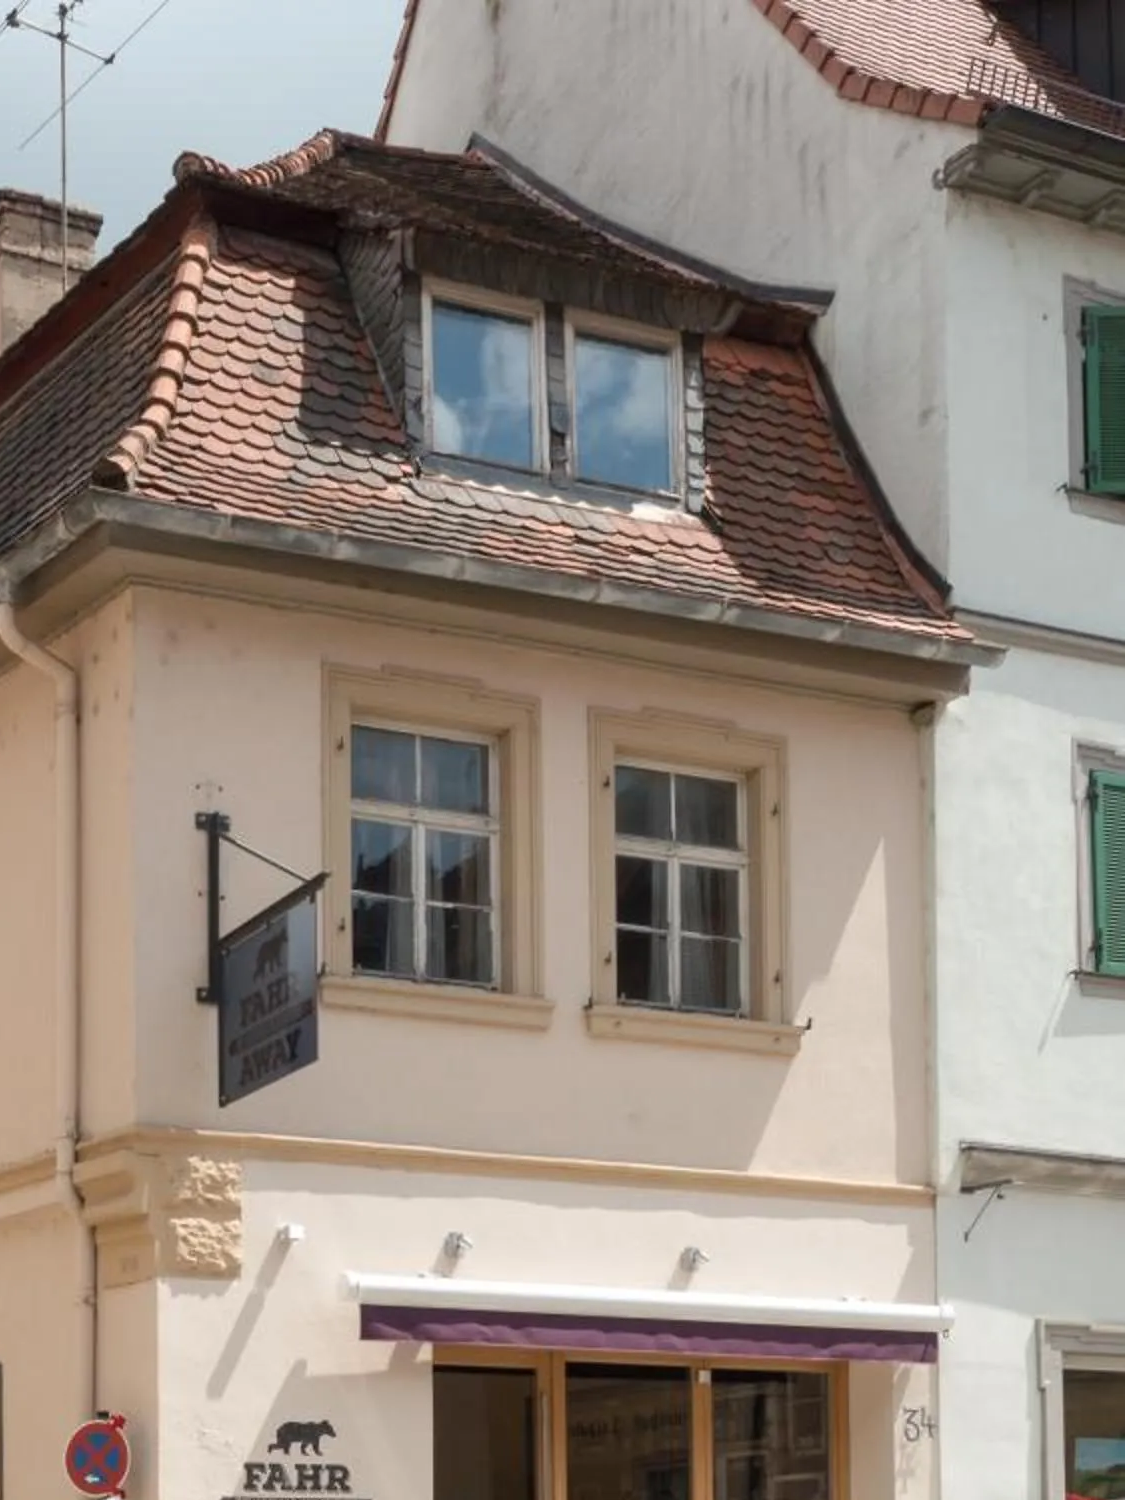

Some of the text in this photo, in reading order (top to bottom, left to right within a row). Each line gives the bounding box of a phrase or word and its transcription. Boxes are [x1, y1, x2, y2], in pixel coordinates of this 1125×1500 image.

[238, 1029, 300, 1087] AWAY
[903, 1406, 939, 1442] 34
[243, 1462, 352, 1493] FAHR
